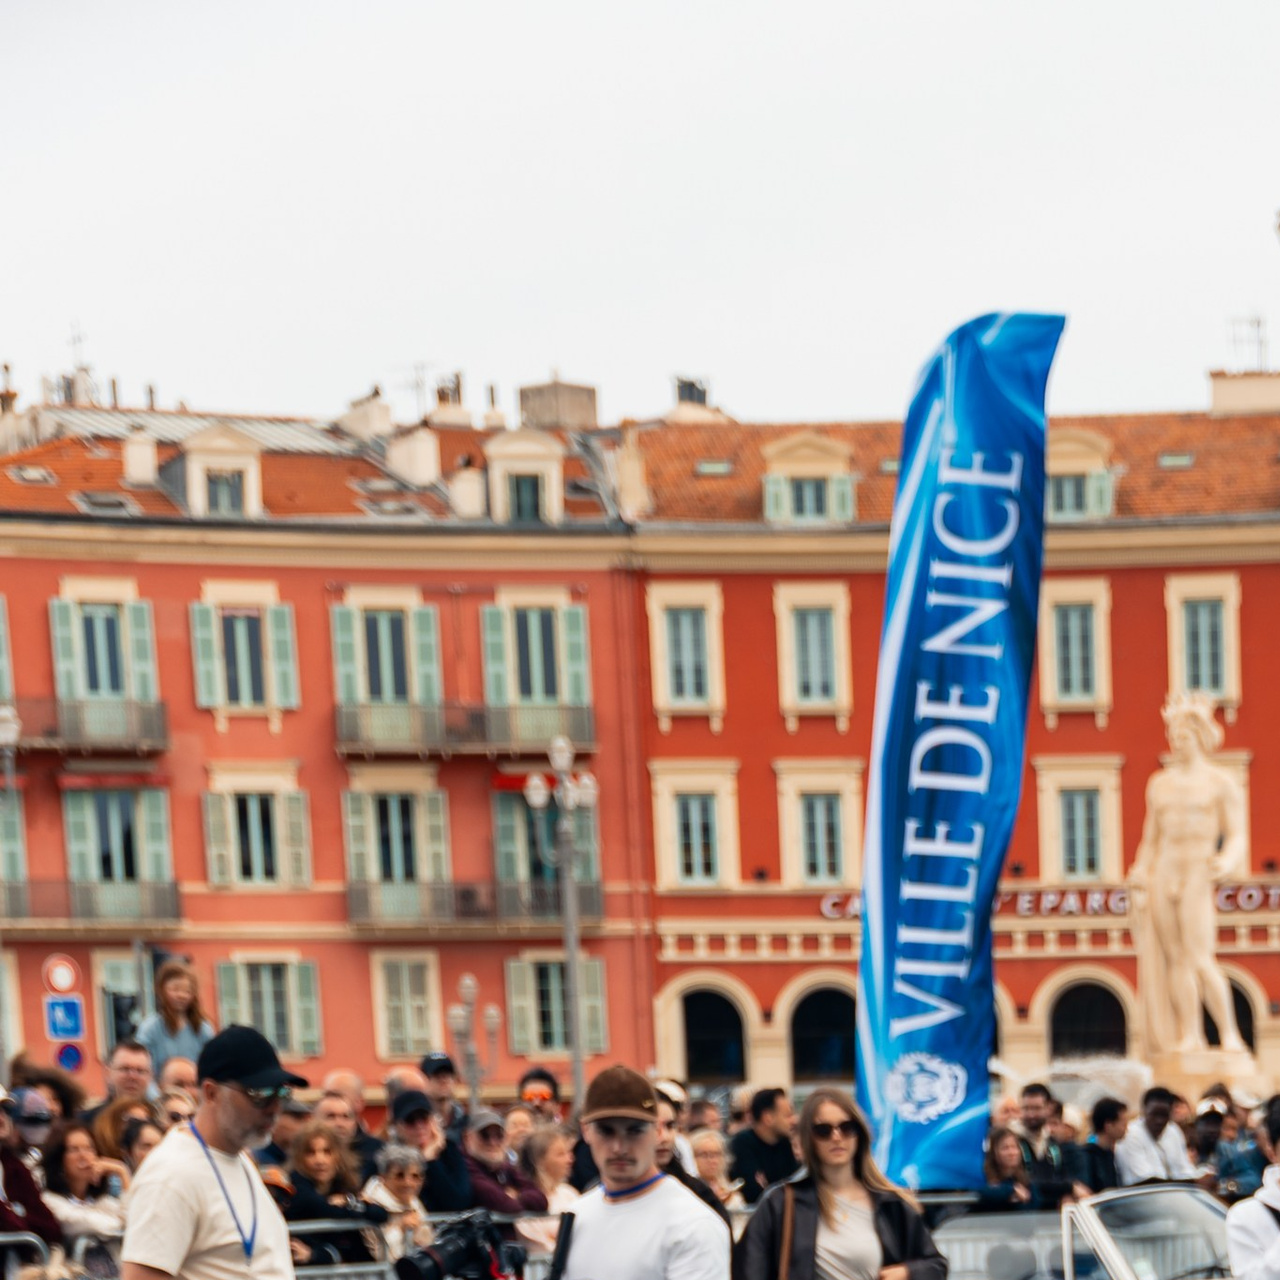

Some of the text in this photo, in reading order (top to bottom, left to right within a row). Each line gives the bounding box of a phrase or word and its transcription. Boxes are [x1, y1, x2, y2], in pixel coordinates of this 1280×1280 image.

[889, 447, 1025, 1038] VILLE DE NICE
